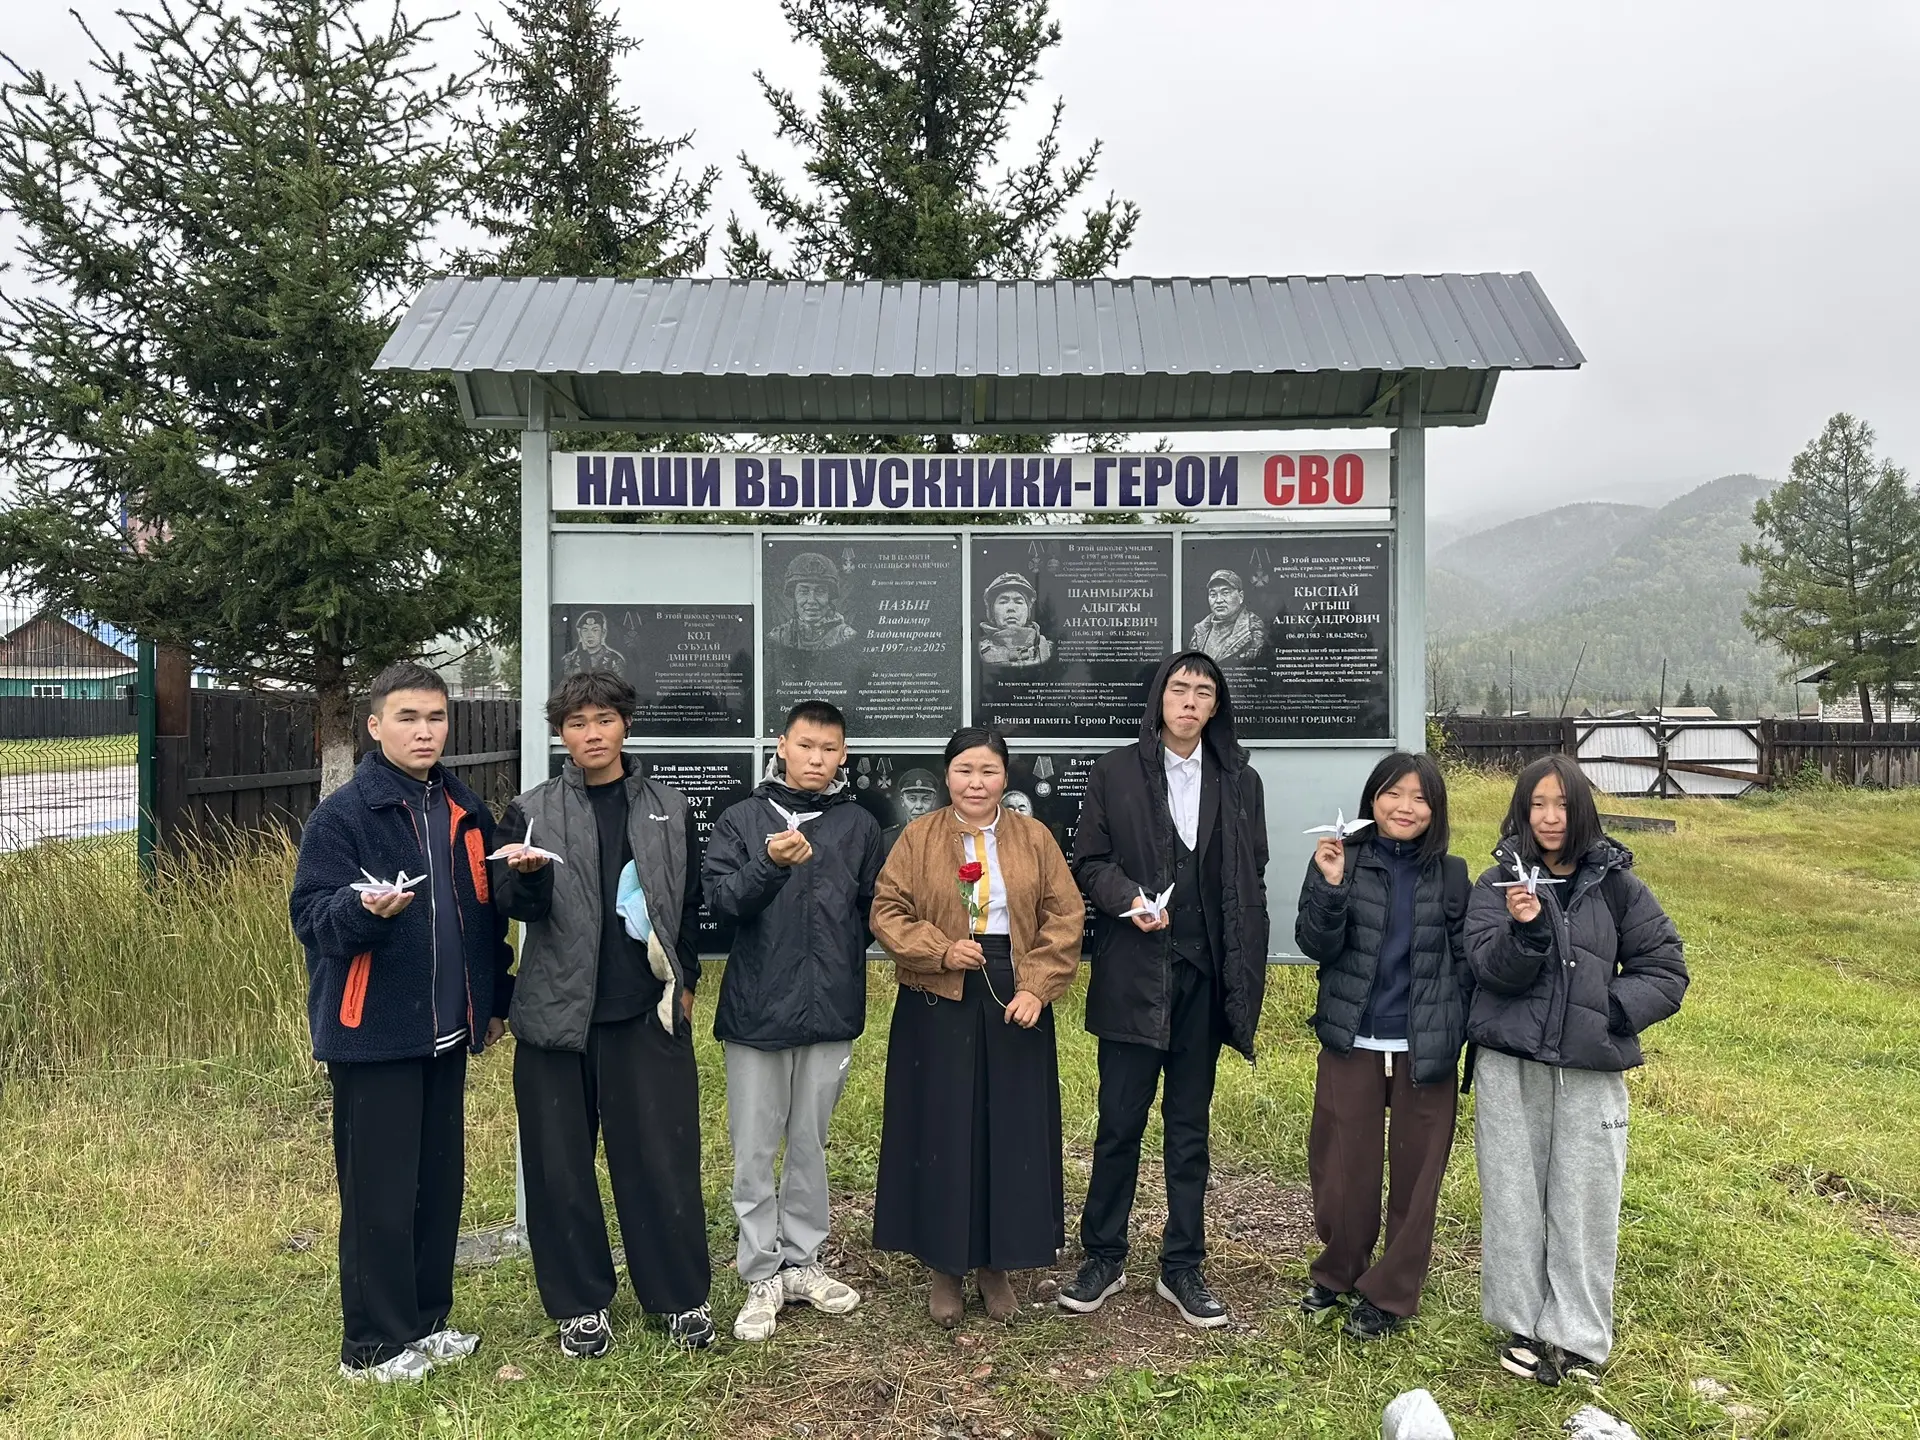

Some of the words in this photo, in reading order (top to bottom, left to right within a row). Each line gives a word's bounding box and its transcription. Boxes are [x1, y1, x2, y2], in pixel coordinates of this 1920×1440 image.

[577, 456, 721, 507] НАШИ
[735, 455, 1238, 508] ВЫПУСКНИКИ-ГЕРОИ
[1264, 453, 1364, 506] СВО
[1077, 544, 1095, 552] этой
[1096, 544, 1122, 552] школе
[1124, 545, 1153, 553] учился
[1282, 556, 1289, 564] В
[1291, 556, 1309, 564] этой
[1341, 556, 1371, 564] учился
[1068, 588, 1154, 598] ШАНМЫРЖЫ
[1294, 584, 1359, 597] КЫСПАЙ
[878, 600, 931, 611] НАЗЫН
[1080, 602, 1141, 614] АДЫГЖЫ
[1302, 601, 1350, 611] АРТЫШ
[656, 612, 662, 620] В
[878, 616, 930, 626] Владимир
[1273, 614, 1380, 625] АЛЕКСАНДРОВИЧ
[1063, 618, 1158, 627] АНАТОЛЬЕВИЧ
[687, 631, 711, 640] КОЛ
[866, 630, 942, 640] Владимирович
[1286, 632, 1320, 640] (06.09.1983
[677, 643, 720, 651] СУБУДАЙ
[666, 654, 731, 662] ДМИТРИЕВИЧ
[994, 715, 1031, 724] Вечная
[1074, 715, 1106, 726] Герою
[1257, 716, 1299, 724] ЛЮБИМ!
[1301, 716, 1356, 724] ГОРДИМСЯ!
[687, 796, 714, 807] ВУТ
